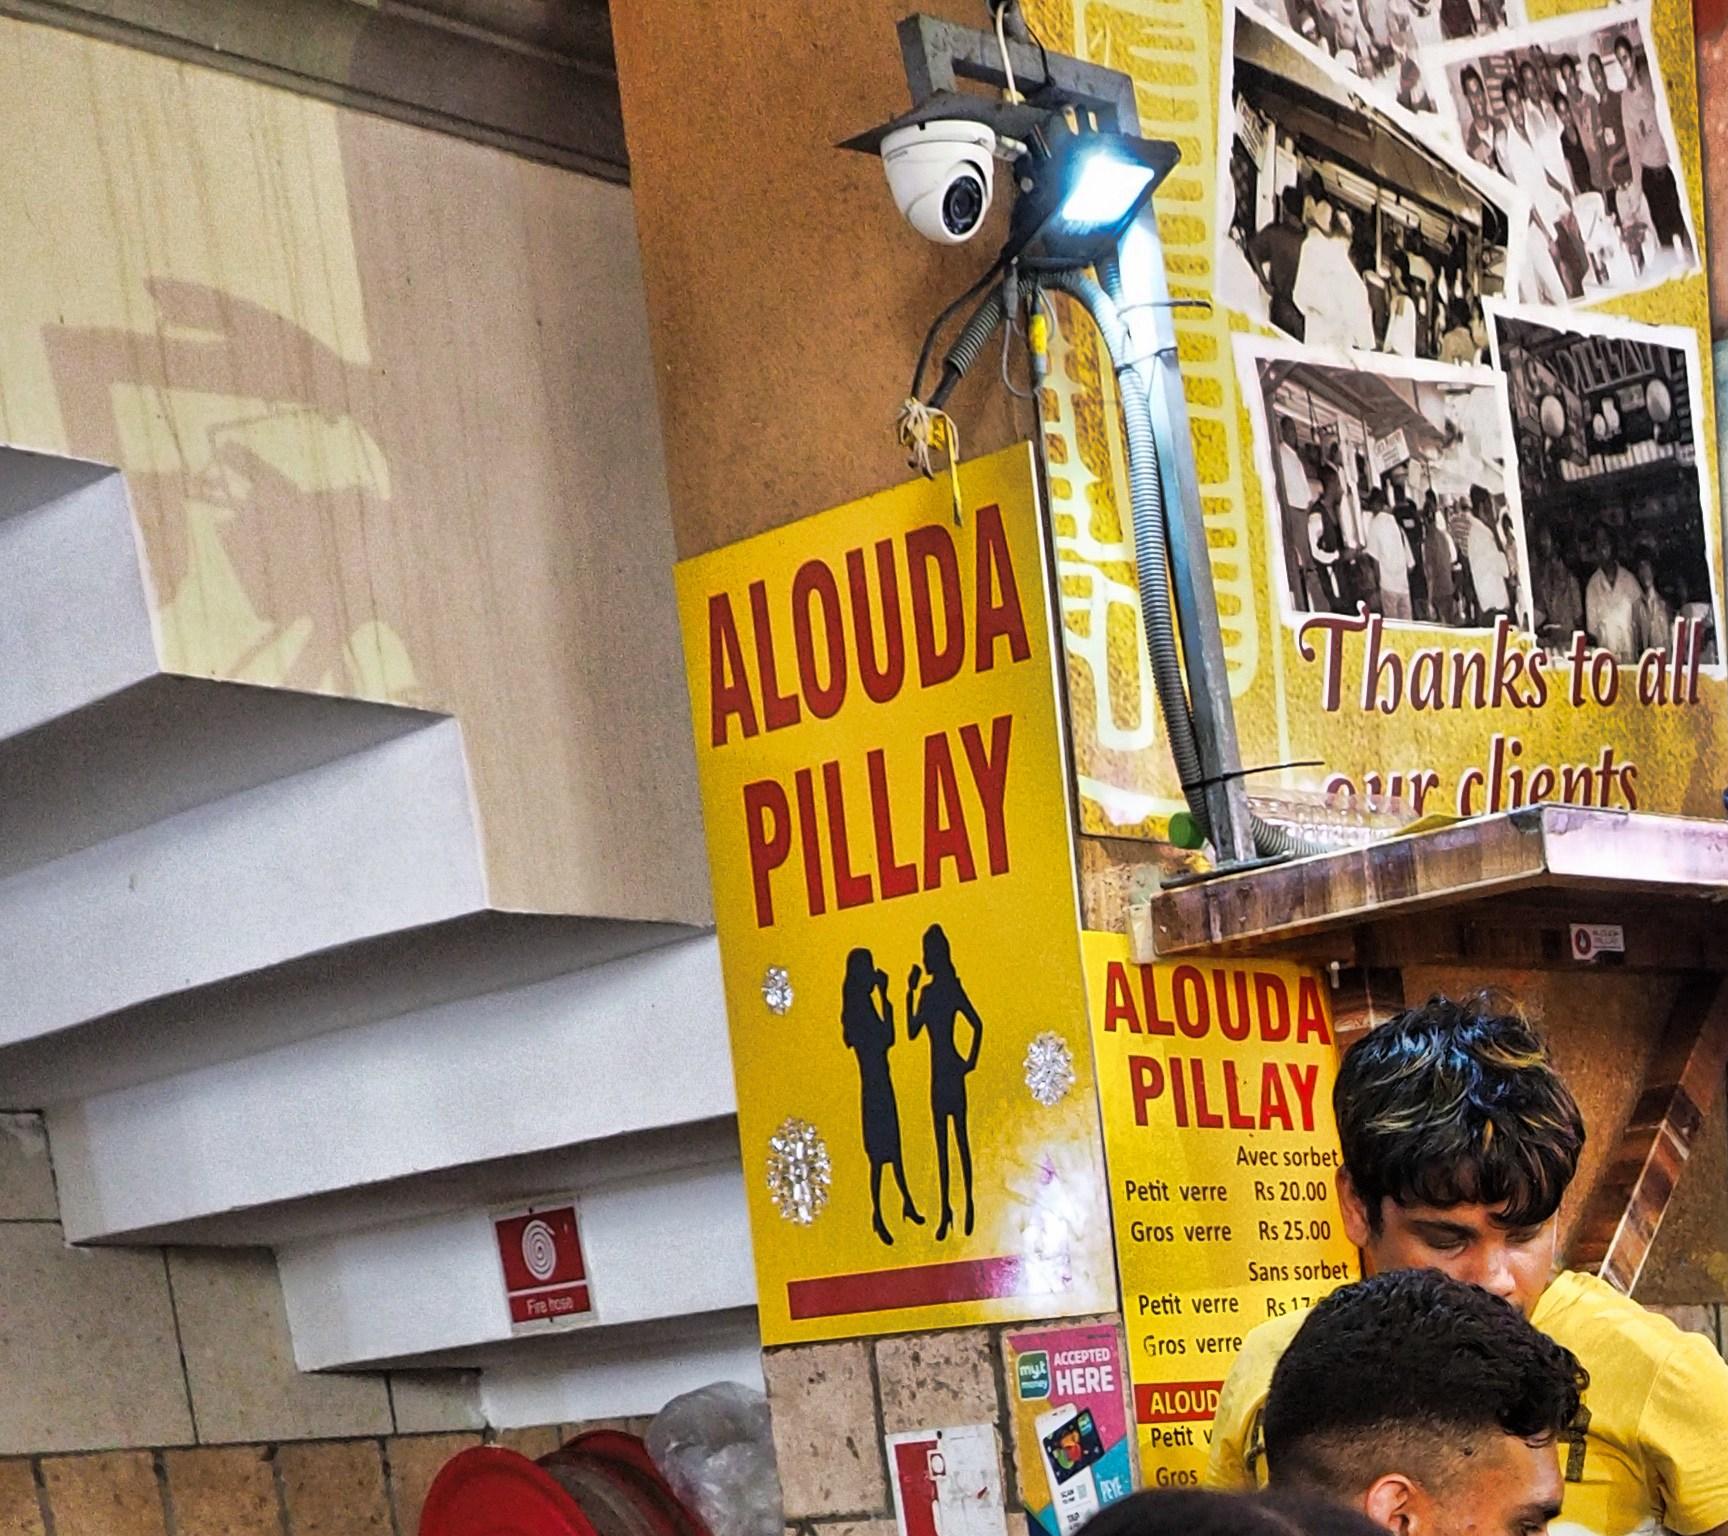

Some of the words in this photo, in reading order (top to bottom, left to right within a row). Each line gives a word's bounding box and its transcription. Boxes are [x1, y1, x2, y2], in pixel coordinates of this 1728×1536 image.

[708, 503, 1031, 748] ALOUDA
[1299, 600, 1548, 715] Thanks
[1568, 630, 1619, 709] to
[1638, 616, 1702, 708] all
[1456, 733, 1639, 817] clients
[743, 714, 1013, 928] PILLAY
[1104, 961, 1332, 1046] ALOUDA
[1128, 1055, 1319, 1131] PILLAY
[1236, 1147, 1278, 1167] Avec
[1283, 1147, 1339, 1167] sorbet
[1125, 1180, 1168, 1200] Petit
[1179, 1184, 1227, 1201] verre
[1255, 1181, 1275, 1200] Rs
[1279, 1181, 1327, 1200] 20.00
[1131, 1221, 1173, 1242] Gros
[1183, 1225, 1232, 1242] verre
[1258, 1221, 1279, 1241] Rs
[1284, 1221, 1331, 1240] 25.00
[1248, 1262, 1289, 1281] Sans
[1294, 1260, 1349, 1280] sorbet
[527, 1300, 547, 1315] Fire
[548, 1296, 574, 1311] hose
[1138, 1293, 1181, 1315] Petit
[1192, 1297, 1239, 1313] verre
[1267, 1297, 1286, 1317] Rs
[1054, 1348, 1111, 1366] ACCEPTED
[1143, 1335, 1186, 1357] Gros
[1196, 1336, 1242, 1353] verre
[1055, 1365, 1115, 1396] HERE
[1150, 1390, 1220, 1415] ALOUD
[1151, 1427, 1193, 1448] Petit
[1156, 1467, 1198, 1487] Gros
